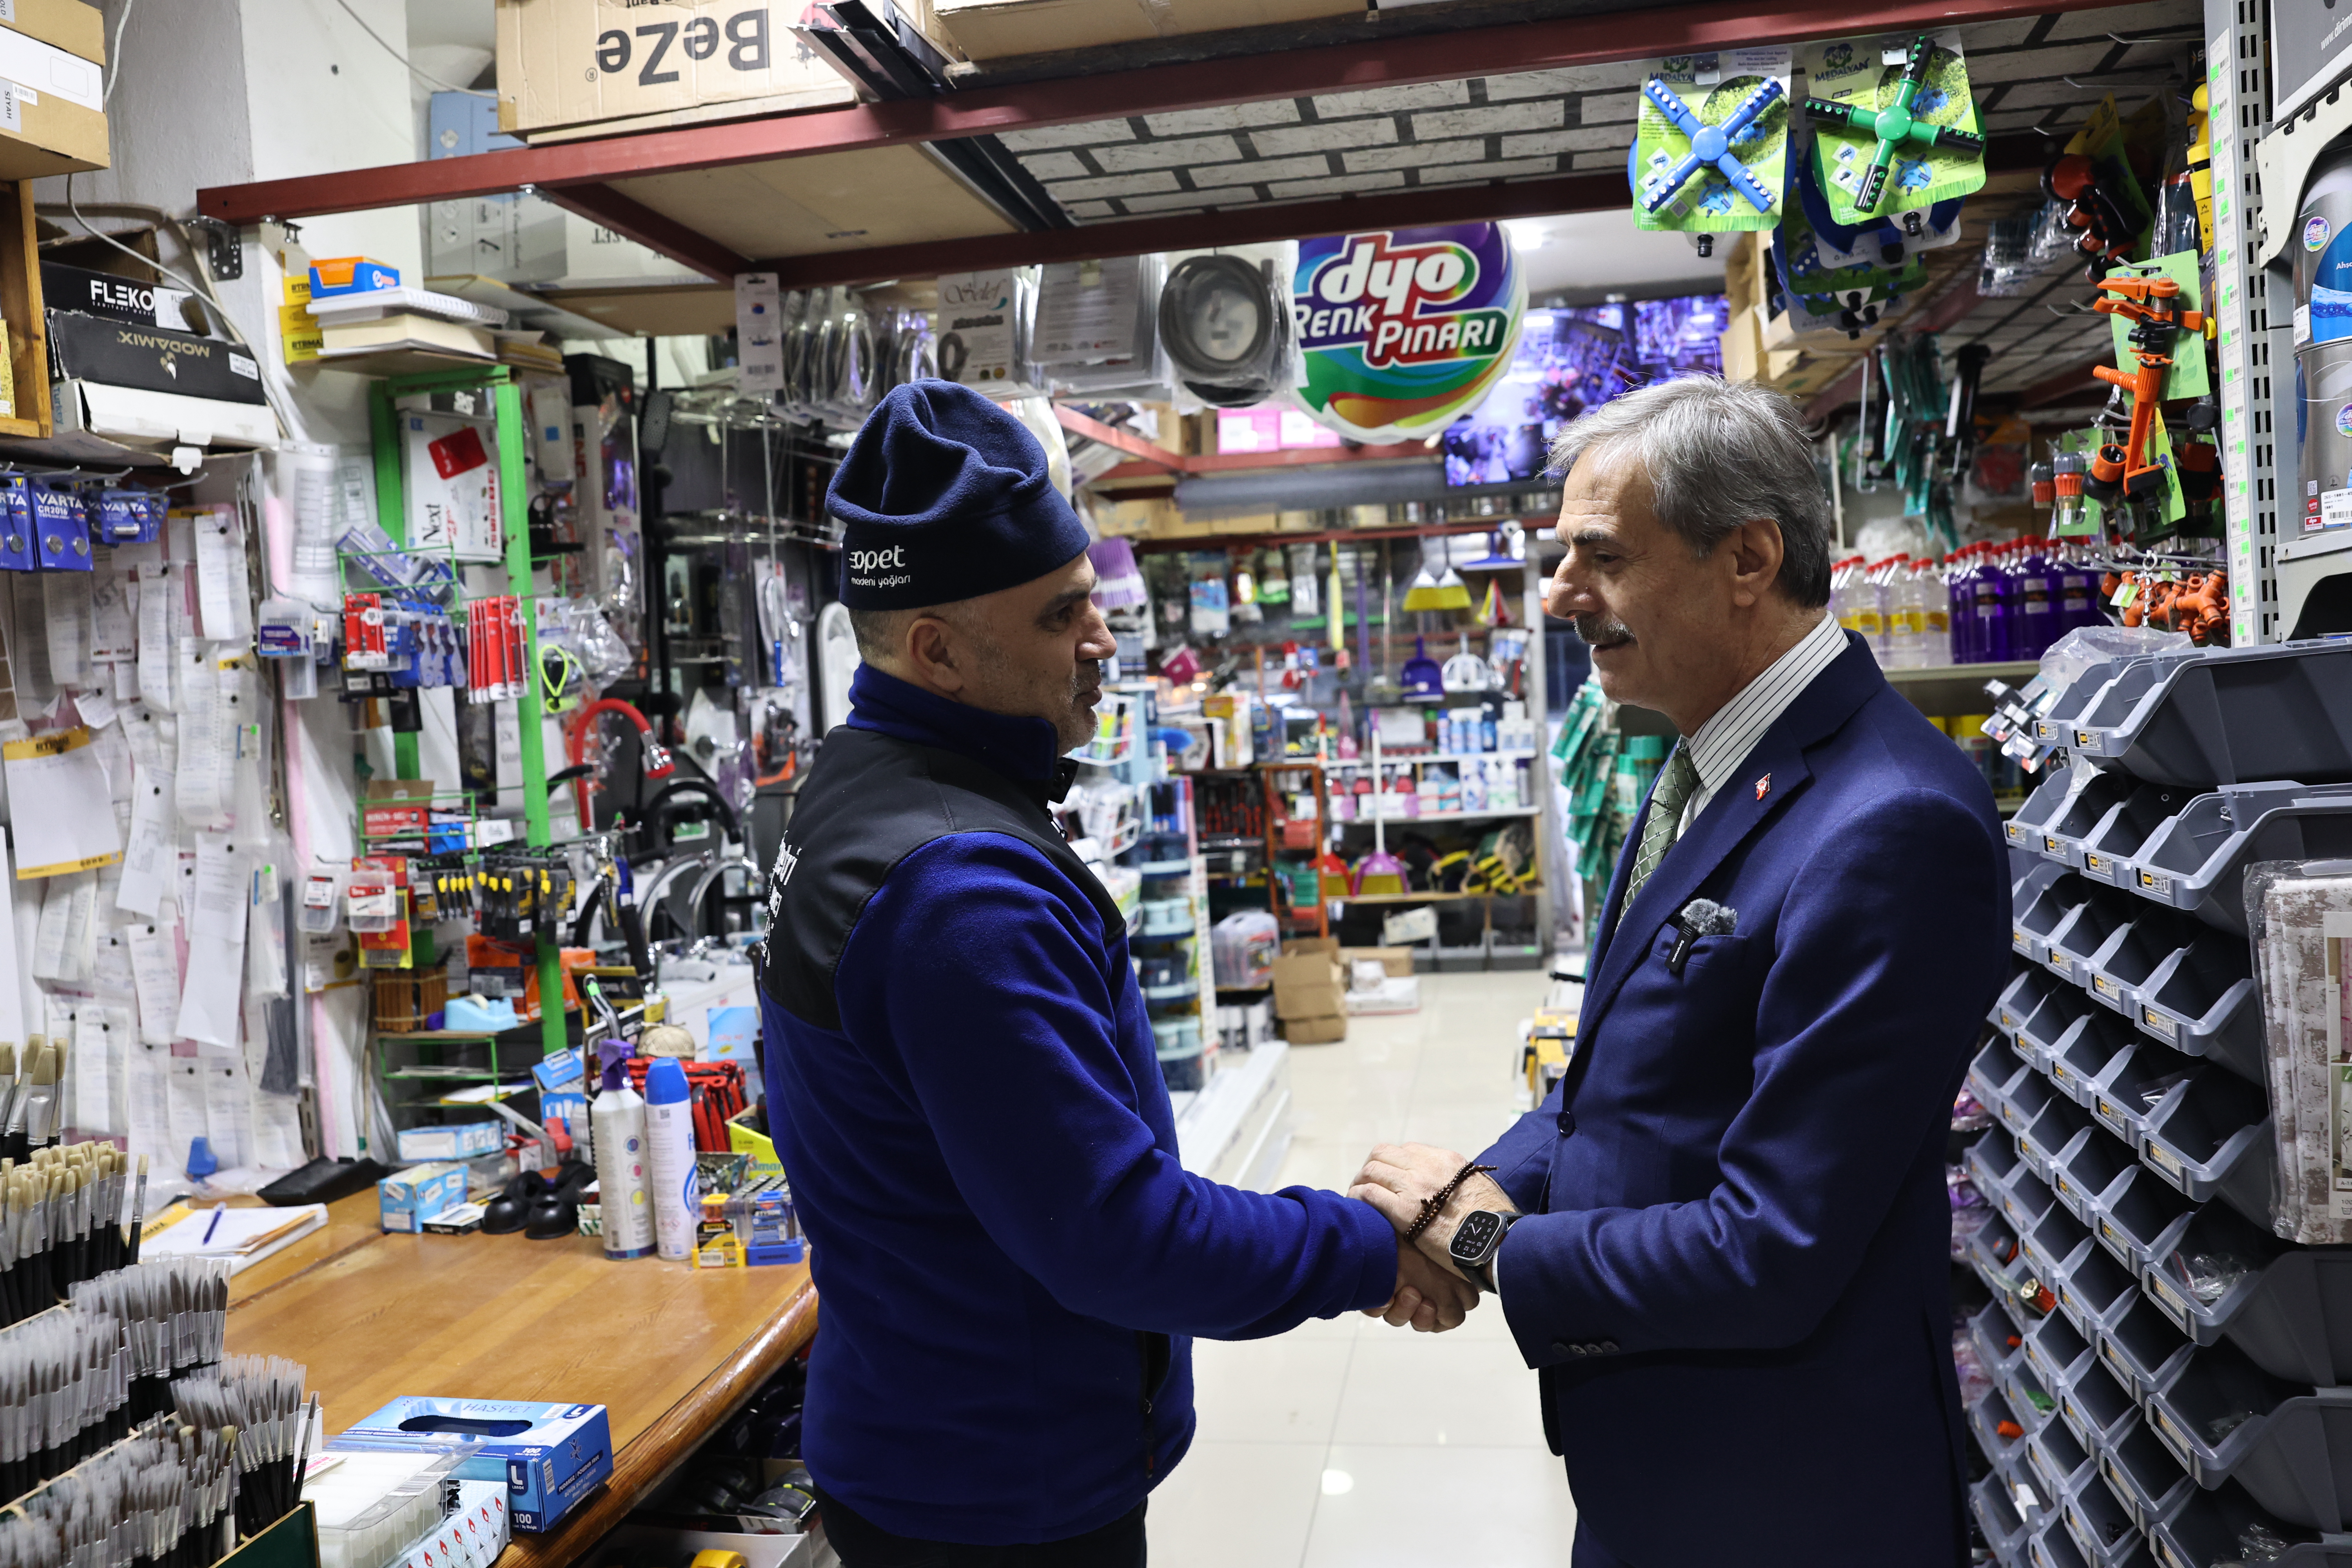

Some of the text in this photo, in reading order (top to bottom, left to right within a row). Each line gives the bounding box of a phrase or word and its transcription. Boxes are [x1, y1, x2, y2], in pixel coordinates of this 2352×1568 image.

[595, 9, 769, 87] BeZe
[1319, 243, 1466, 316] dyo
[91, 279, 155, 311] FLEKO
[1296, 303, 1380, 340] RENK
[118, 331, 210, 358] MODAMIX
[53, 386, 64, 425] Turkey
[36, 492, 84, 510] VARTA
[422, 503, 443, 543] Next
[849, 545, 906, 575] opet
[851, 575, 911, 588] madeni yağları
[752, 1160, 784, 1172] Smar
[462, 1403, 536, 1413] HASPET
[570, 1406, 585, 1415] L
[511, 1465, 523, 1485] L
[514, 1513, 532, 1524] 100
